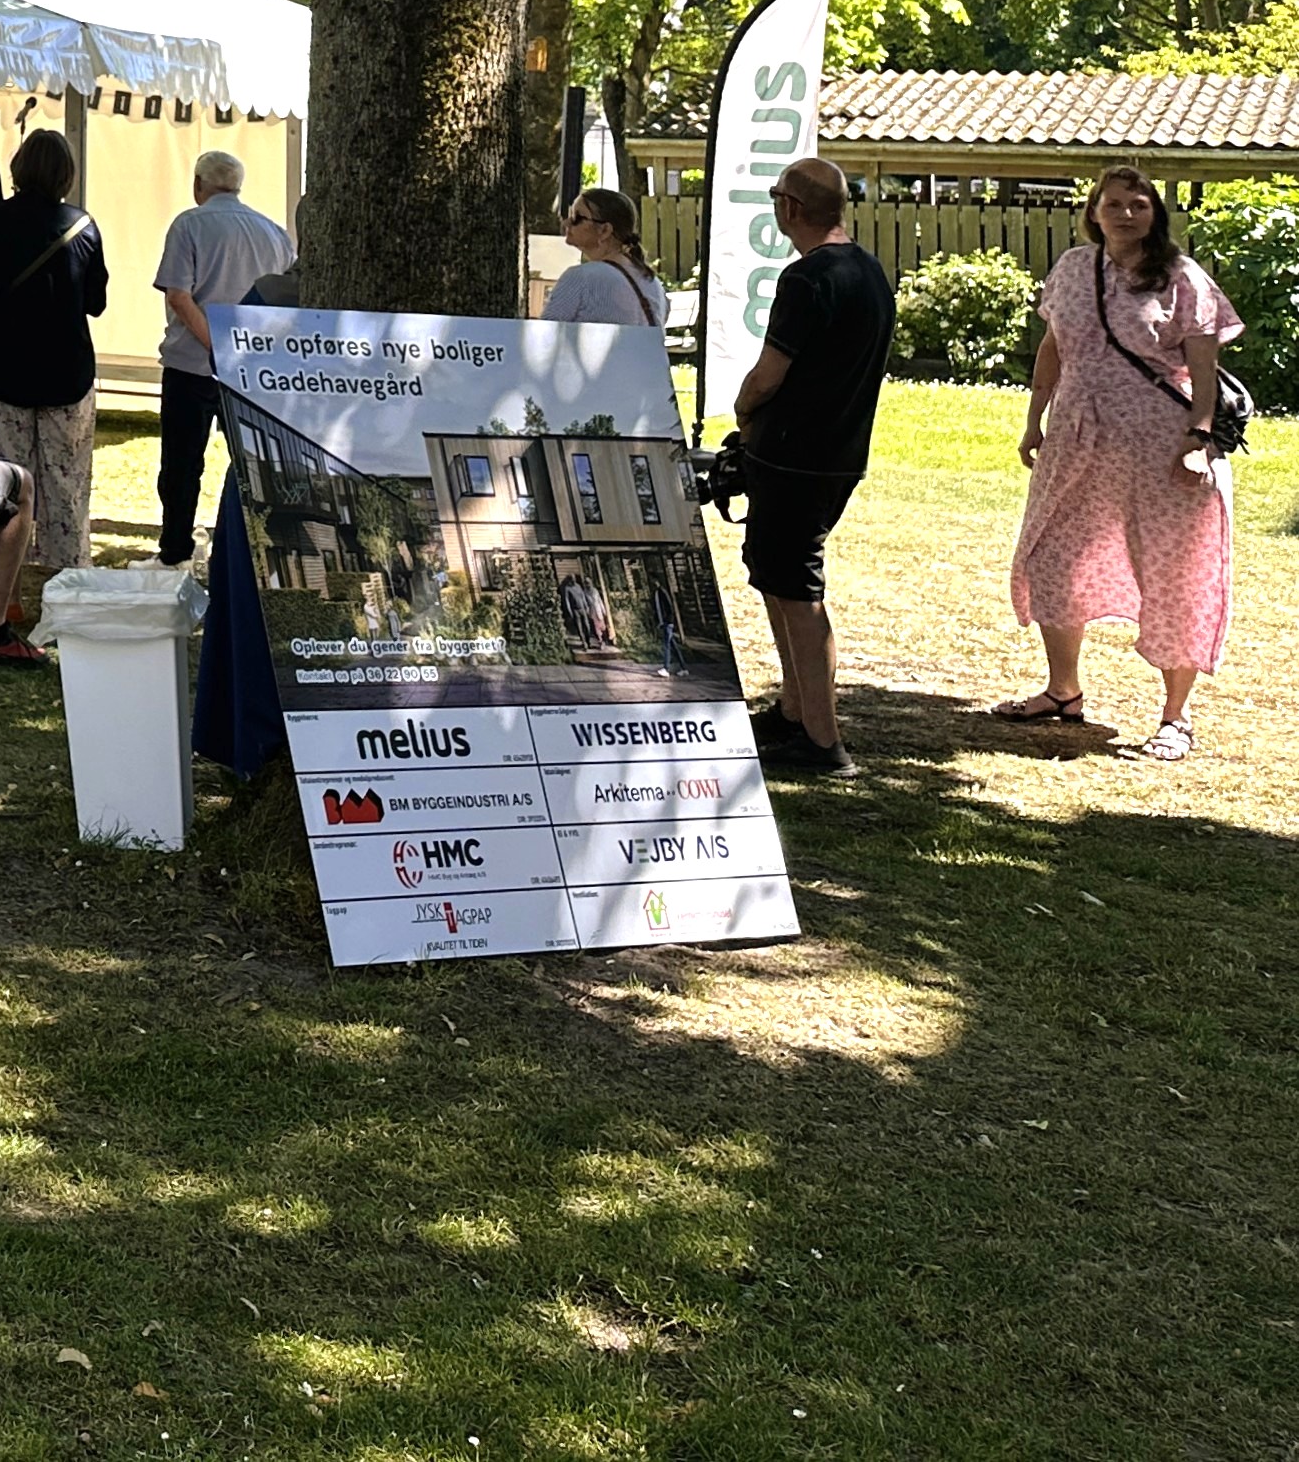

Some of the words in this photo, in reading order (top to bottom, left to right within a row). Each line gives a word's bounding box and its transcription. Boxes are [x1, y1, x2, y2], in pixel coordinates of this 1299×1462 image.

[233, 329, 274, 352] Her
[286, 333, 372, 359] opføres
[382, 340, 421, 363] nye
[431, 339, 505, 368] boliger
[240, 368, 249, 389] i
[259, 368, 423, 400] Gadehavegård
[292, 640, 342, 657] Oplever
[350, 639, 367, 653] du
[372, 641, 408, 656] gener
[415, 639, 433, 653] fra
[385, 669, 399, 680] 22
[403, 668, 418, 680] 90
[423, 667, 437, 679] 55
[356, 719, 472, 761] melius
[570, 720, 717, 748] WISSENBERG
[389, 797, 410, 811] BM
[413, 793, 510, 811] BYGGEINDUSTRI
[512, 792, 534, 807] A/S
[594, 783, 665, 803] Arkitema
[677, 778, 724, 800] COWI
[421, 838, 484, 868] HMC
[618, 835, 686, 864] VEJBY
[416, 902, 444, 920] JYSK
